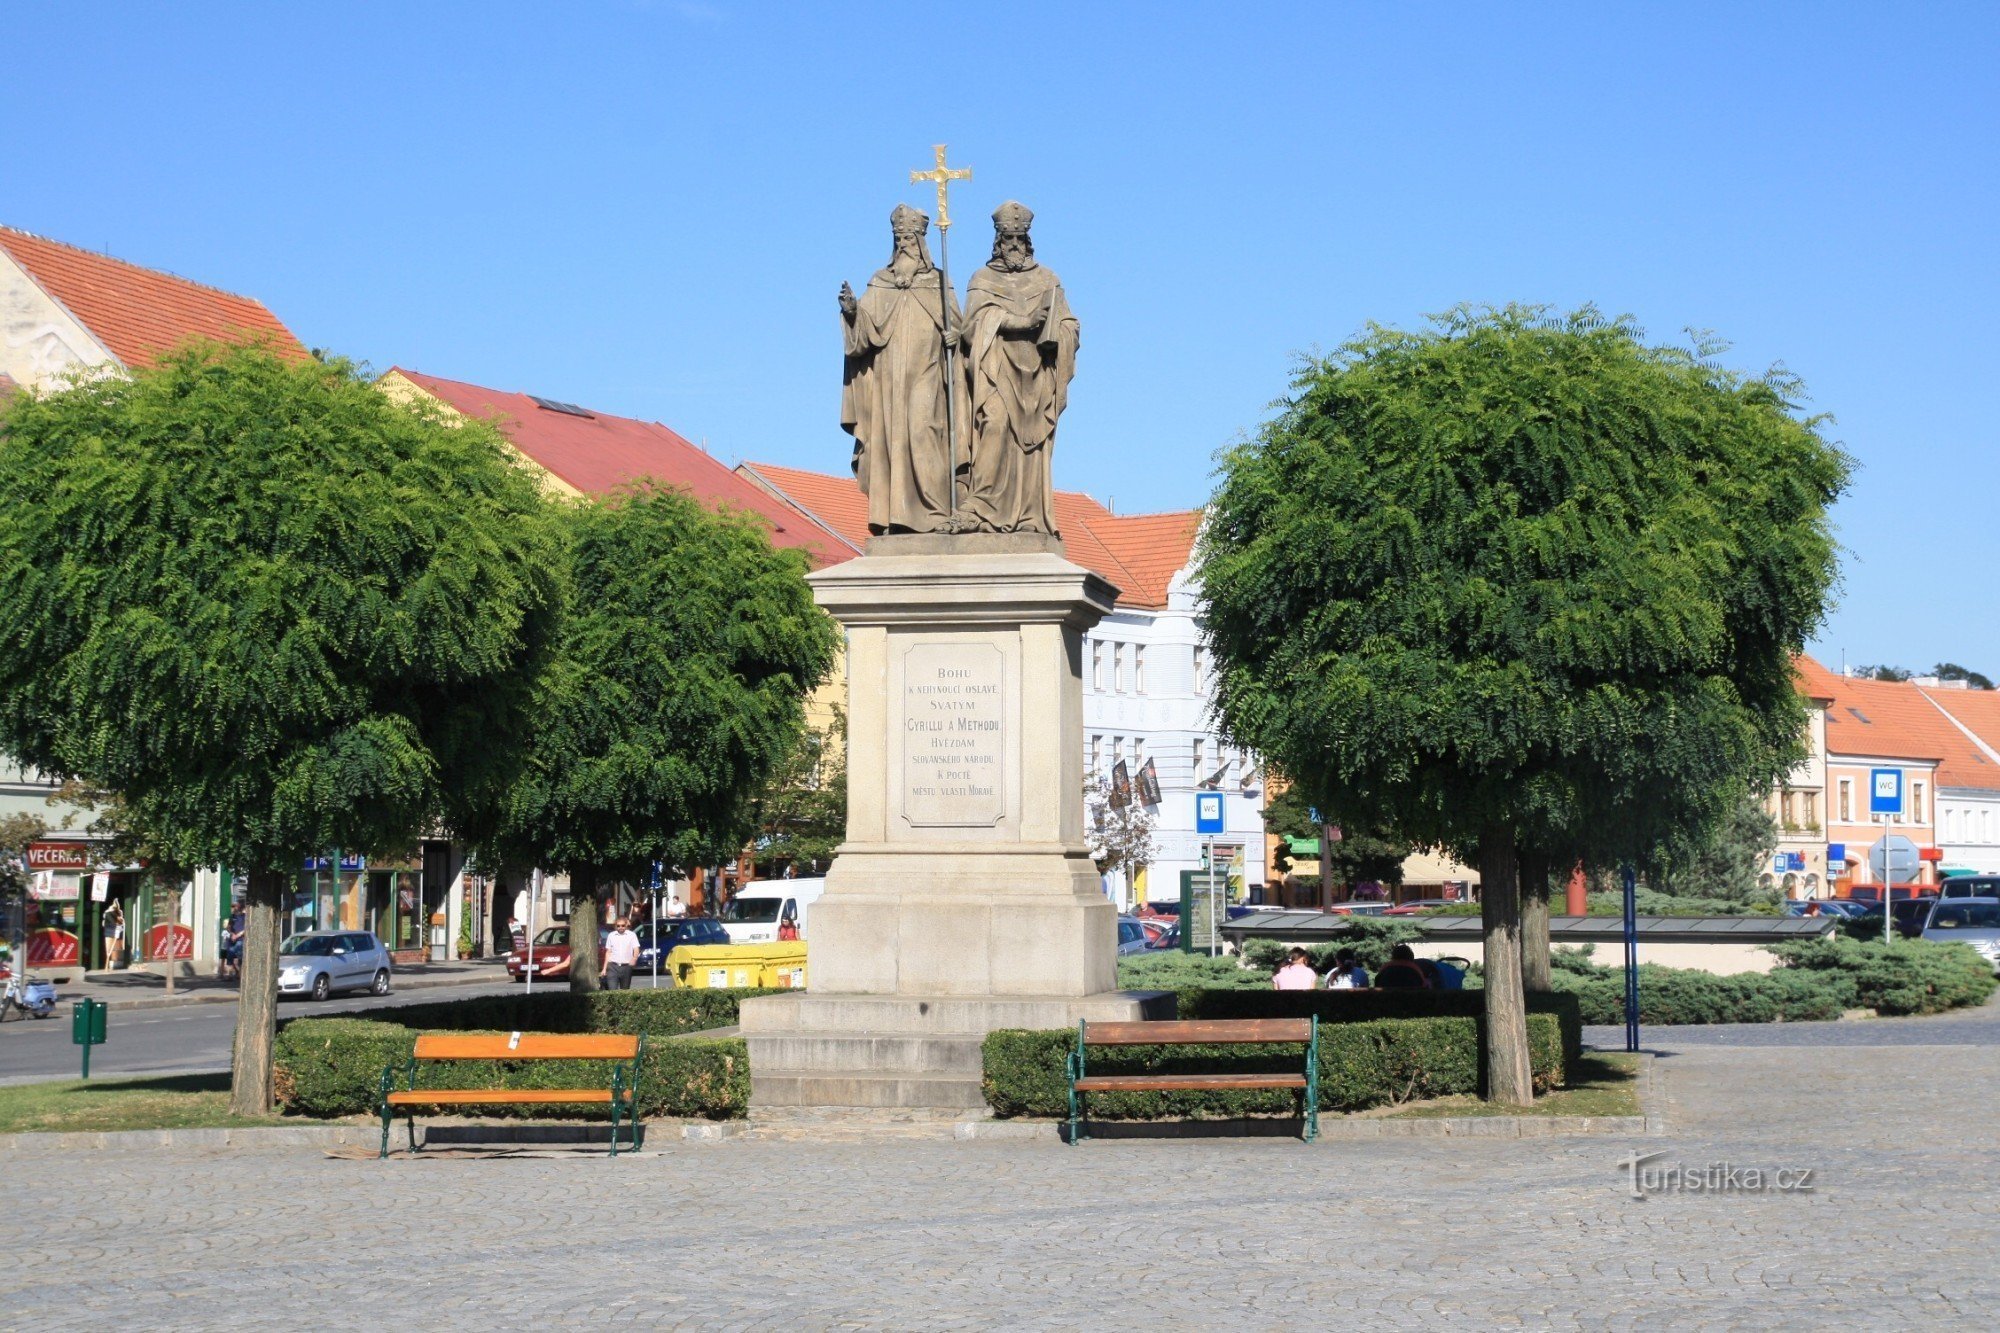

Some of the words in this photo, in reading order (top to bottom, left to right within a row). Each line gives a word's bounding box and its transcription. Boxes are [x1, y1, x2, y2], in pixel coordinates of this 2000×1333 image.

[938, 668, 972, 679] BOHU
[907, 718, 943, 731] CYRILLU
[948, 721, 954, 731] A
[957, 717, 999, 731] METHODU
[1879, 782, 1894, 790] WC
[1203, 805, 1216, 813] WC
